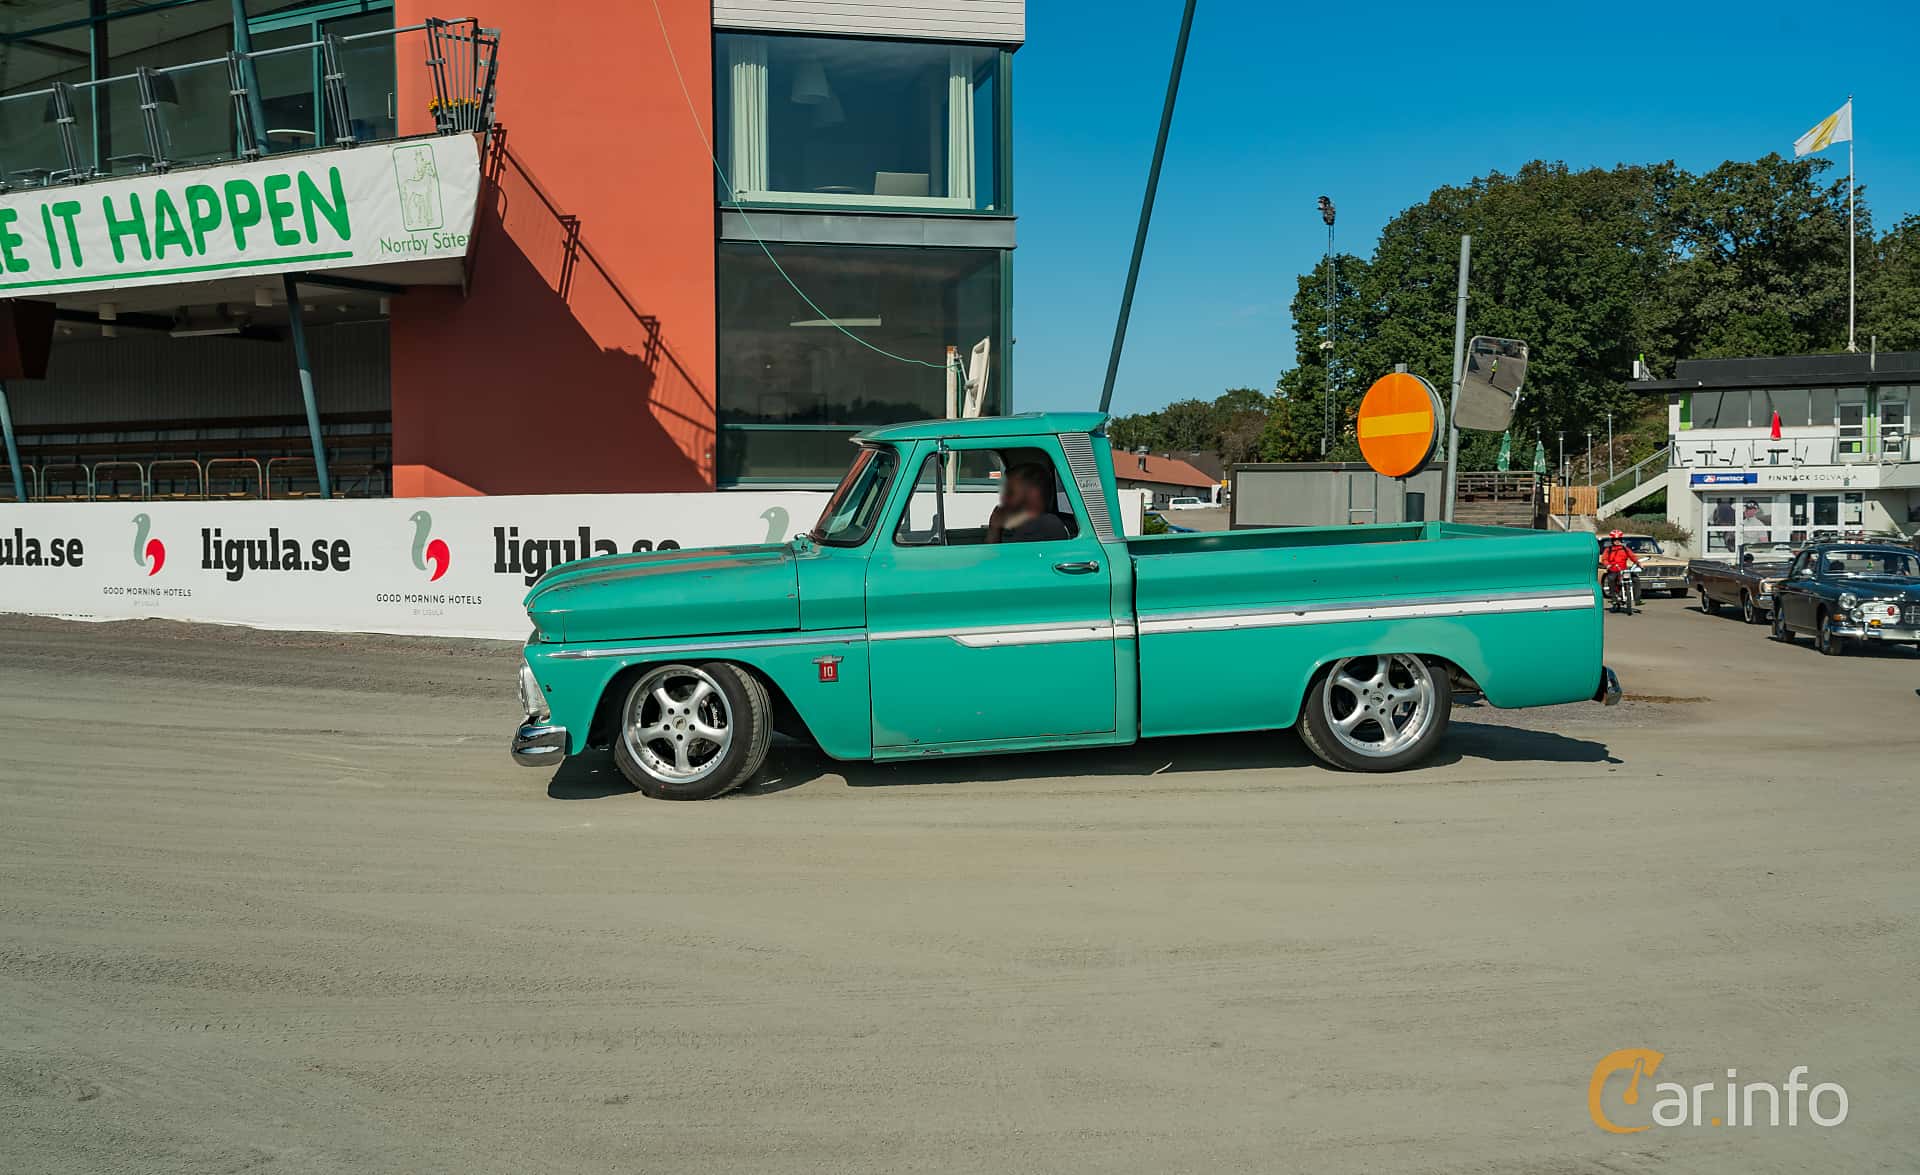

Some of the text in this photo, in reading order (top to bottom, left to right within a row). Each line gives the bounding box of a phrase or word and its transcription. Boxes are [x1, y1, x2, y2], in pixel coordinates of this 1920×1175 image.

[0, 167, 352, 275] E IT HAPPEN
[379, 233, 429, 255] Norrby
[1814, 473, 1858, 482] SOLVAA
[0, 528, 84, 567] ula.se
[201, 527, 351, 582] ligula.se
[493, 526, 681, 587] ligul
[103, 586, 192, 597] GOOD MORNING HOTELS
[376, 593, 482, 605] GOOD MORNING HOTELS
[823, 665, 834, 678] 10
